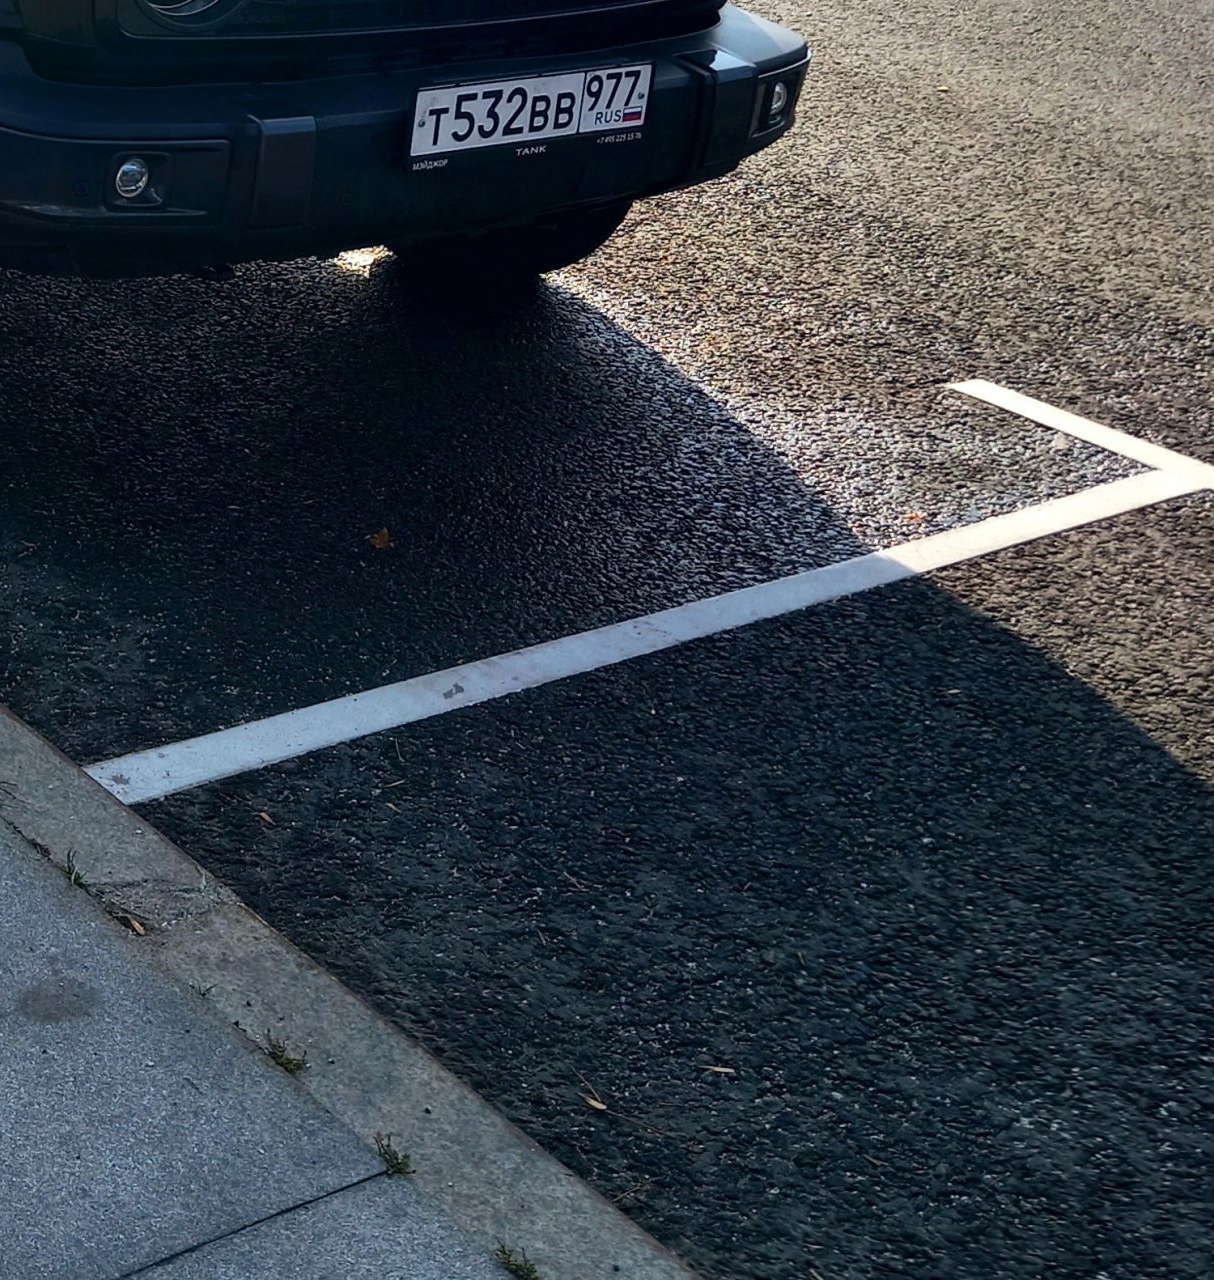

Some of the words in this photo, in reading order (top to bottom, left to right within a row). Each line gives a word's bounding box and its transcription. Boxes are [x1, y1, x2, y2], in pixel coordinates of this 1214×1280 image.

[429, 87, 575, 146] Т532ВВ
[586, 70, 641, 112] 977
[595, 110, 621, 125] RUS
[516, 145, 546, 157] TANK
